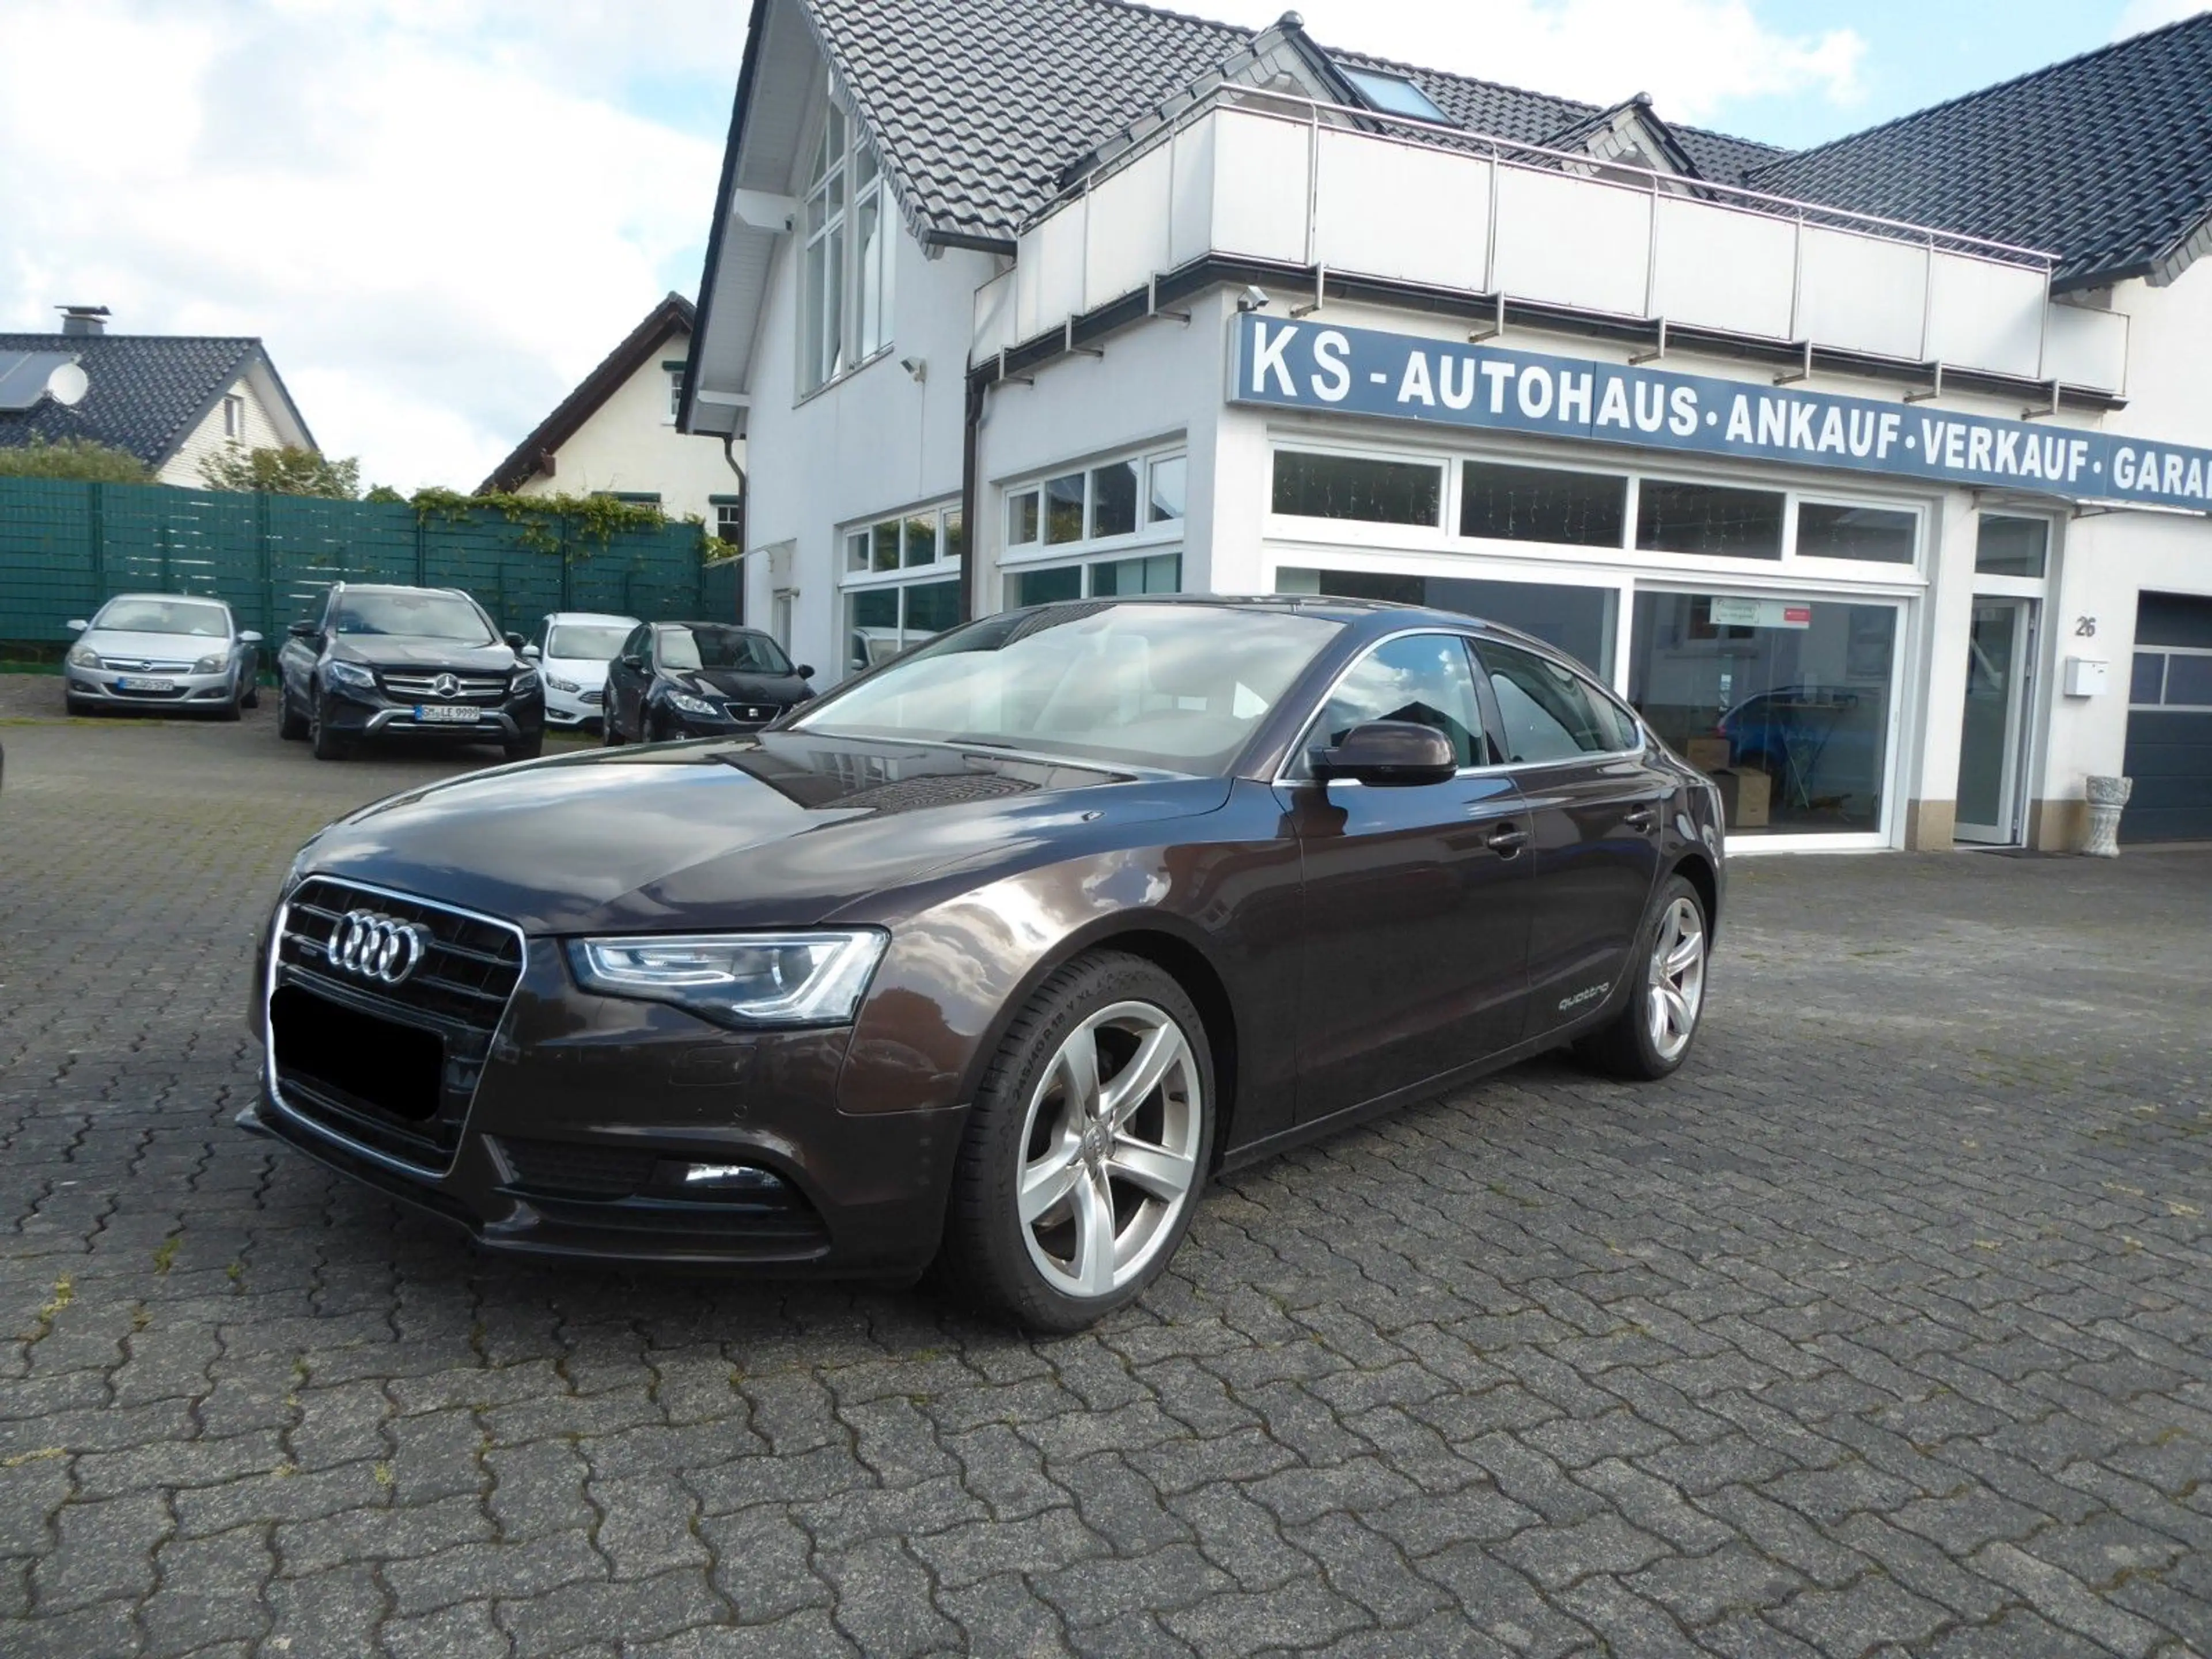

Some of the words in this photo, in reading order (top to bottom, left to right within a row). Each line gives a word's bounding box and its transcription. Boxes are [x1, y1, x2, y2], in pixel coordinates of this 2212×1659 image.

[1725, 393, 1901, 459] ANKAUF
[1921, 418, 2089, 482] VERKAUF
[2075, 615, 2096, 638] 26
